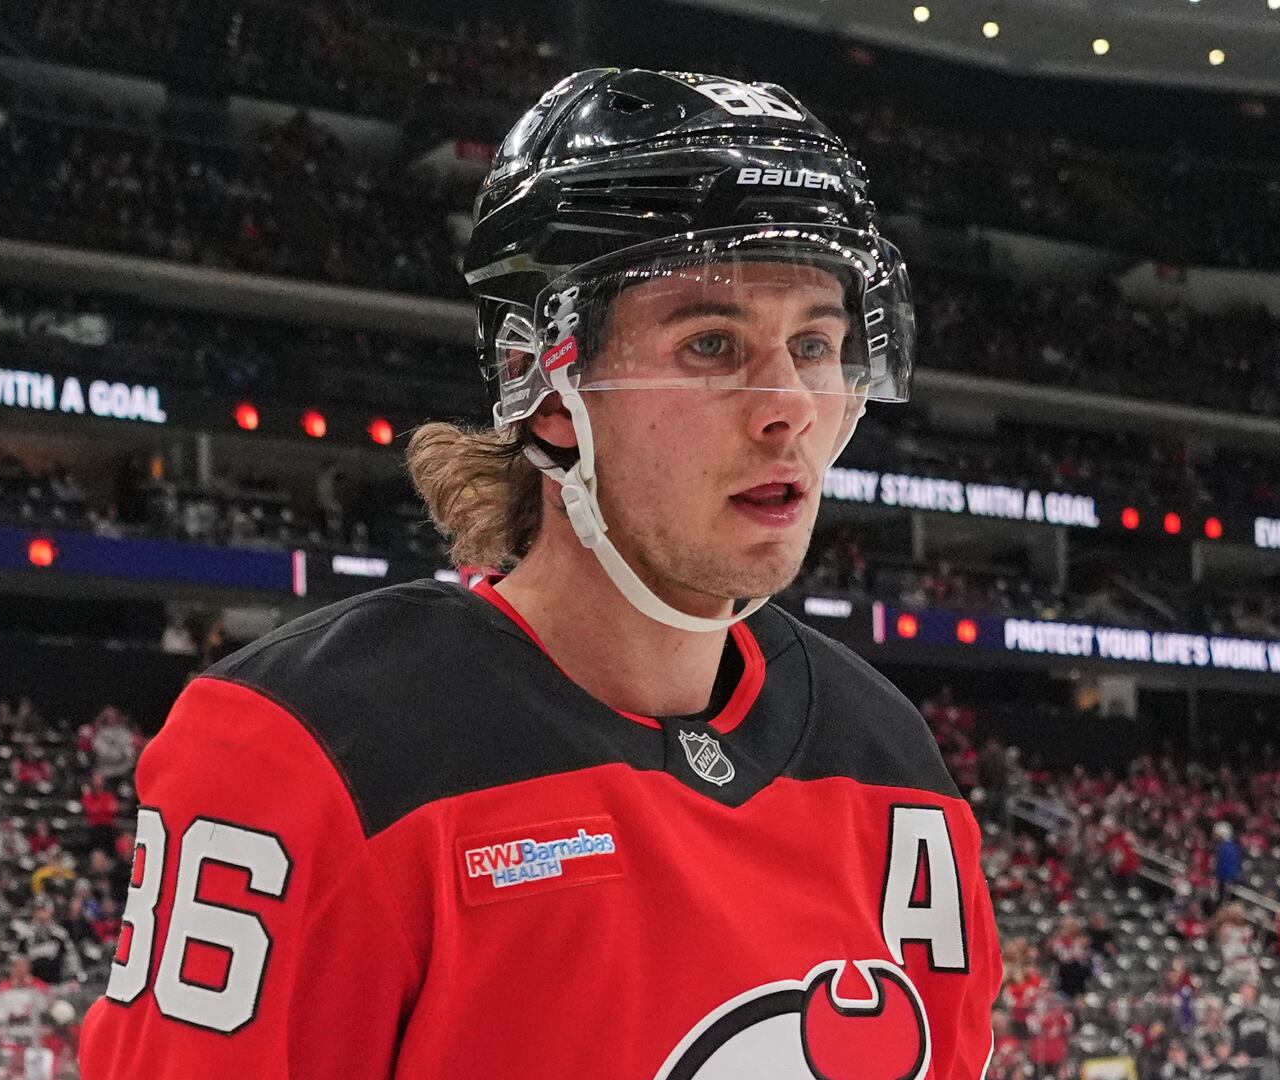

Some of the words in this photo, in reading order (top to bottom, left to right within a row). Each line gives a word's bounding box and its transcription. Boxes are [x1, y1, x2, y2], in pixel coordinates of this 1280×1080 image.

[695, 82, 807, 121] 86
[60, 377, 85, 413] A
[89, 381, 166, 423] GOAL
[881, 474, 965, 512] STARTS
[967, 485, 1024, 518] WITH
[1026, 491, 1044, 521] A
[1045, 493, 1099, 527] GOAL
[1004, 619, 1094, 656] PROTECT
[1096, 627, 1151, 661] YOUR
[1152, 633, 1210, 665] LIFE'S
[1210, 638, 1268, 670] WORK
[696, 746, 717, 772] NHL
[467, 830, 615, 876] RWJBarnabas
[493, 860, 560, 886] HEALTH
[882, 804, 970, 973] A
